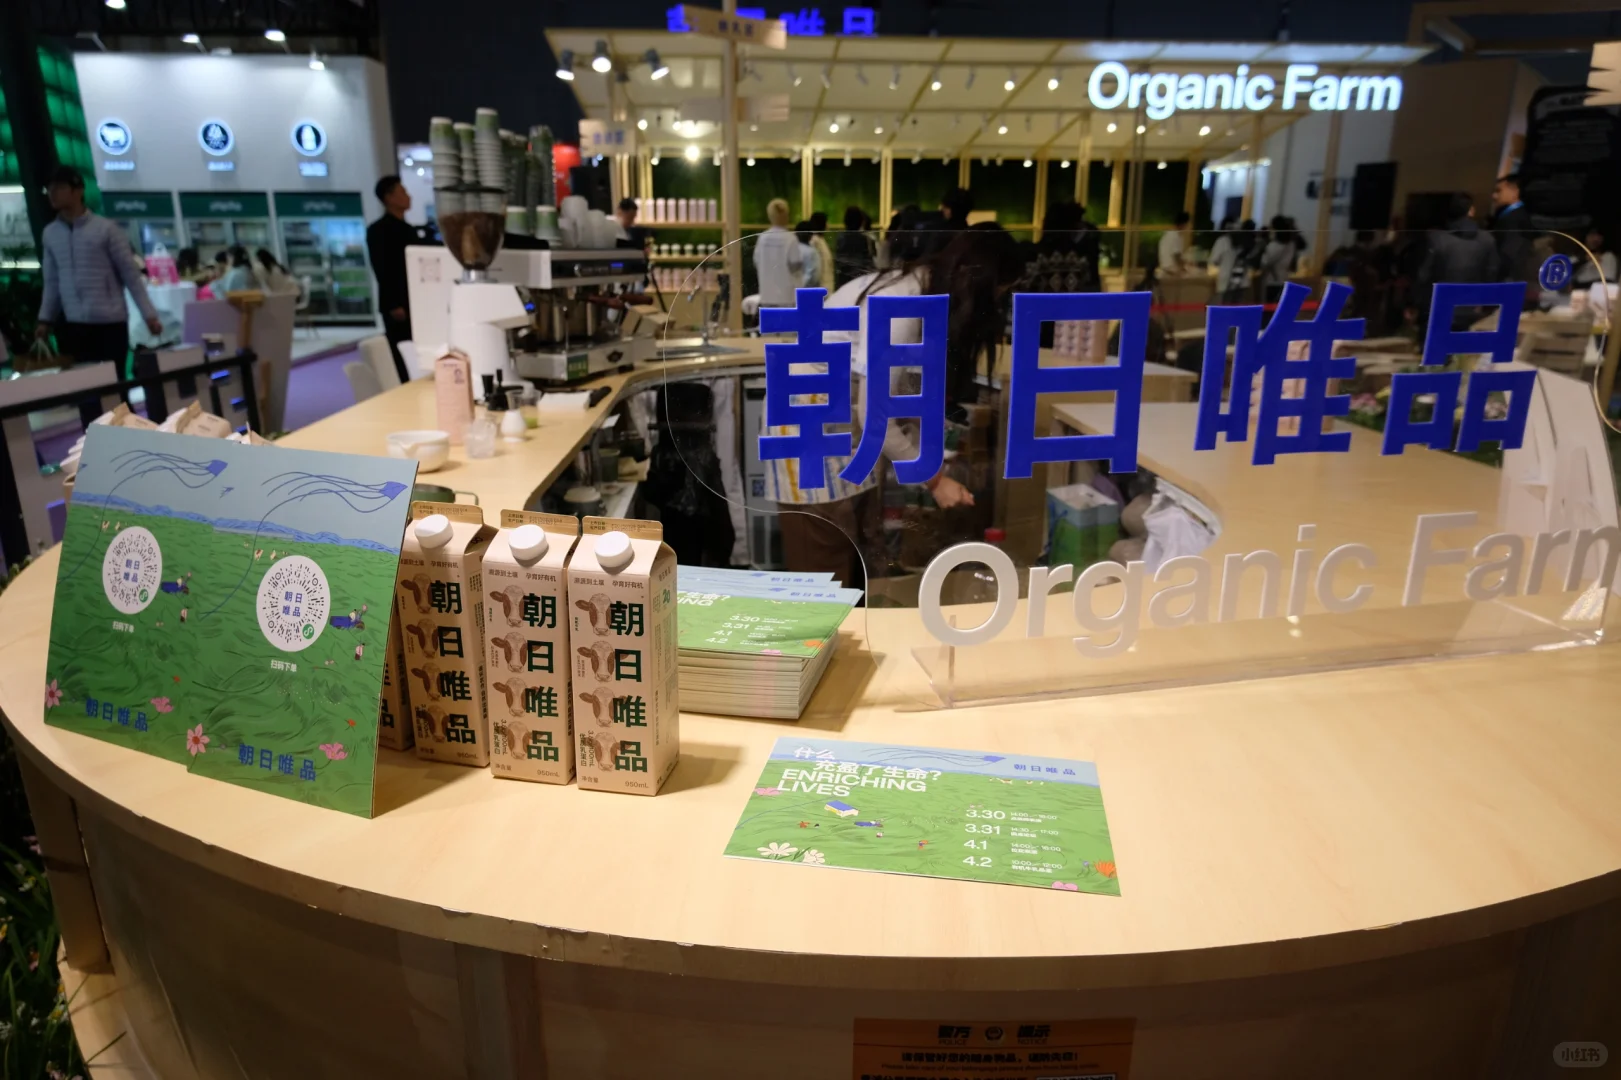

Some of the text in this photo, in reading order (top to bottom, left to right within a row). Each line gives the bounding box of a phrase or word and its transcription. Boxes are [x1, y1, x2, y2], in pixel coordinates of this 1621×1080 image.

[1087, 60, 1403, 121] Organic Farm
[758, 281, 1537, 489] 朝日唯品
[919, 512, 1621, 658] Organic Farm
[284, 591, 303, 604] 朝日
[270, 659, 297, 672] 扫码下单
[430, 580, 476, 744] 朝日唯品
[523, 592, 559, 762] 朝日唯品
[609, 600, 648, 773] 朝日唯品
[86, 696, 148, 732] 朝日唯品
[238, 743, 317, 782] 朝日唯品
[1013, 763, 1077, 776] 朝日唯品
[624, 780, 649, 789] 950mL
[776, 780, 850, 797] LIVES
[781, 768, 927, 792] ENRICHING
[965, 809, 1006, 820] 3.30
[964, 823, 1001, 835] 3.31
[963, 839, 987, 850] 4.1
[962, 855, 992, 868] 4.2
[938, 1038, 968, 1046] POLICE
